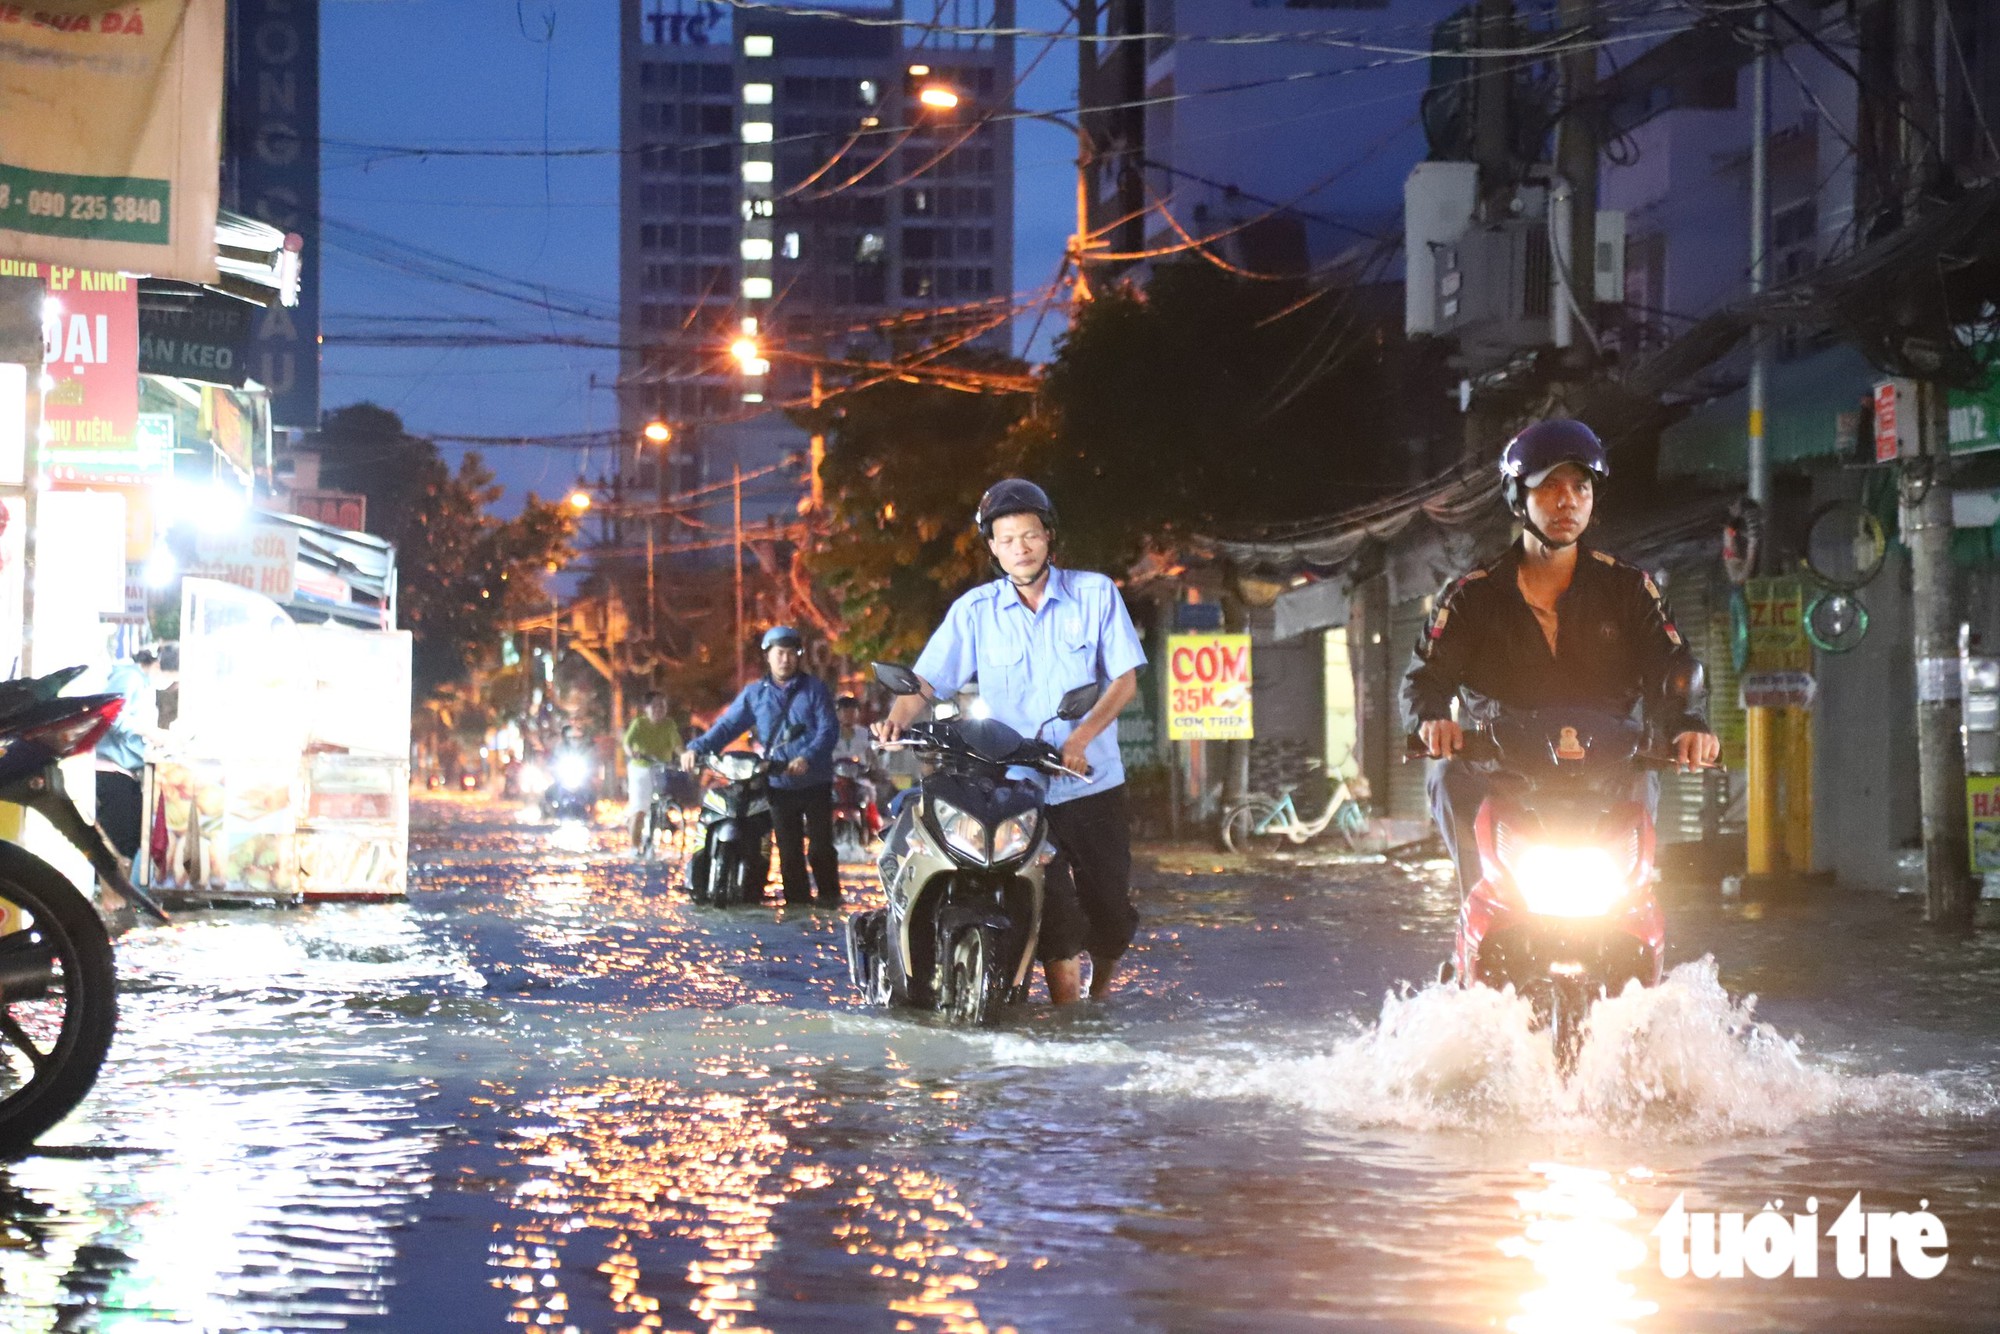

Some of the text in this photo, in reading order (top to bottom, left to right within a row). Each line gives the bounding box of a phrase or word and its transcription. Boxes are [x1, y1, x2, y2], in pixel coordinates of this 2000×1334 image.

[647, 12, 709, 46] TTC
[28, 189, 66, 217] 090
[70, 194, 108, 220] 235
[112, 195, 161, 224] 3840
[181, 342, 234, 370] KEO
[1750, 602, 1798, 627] ZIC
[1172, 639, 1249, 684] CƠM
[1173, 686, 1215, 714] 35K
